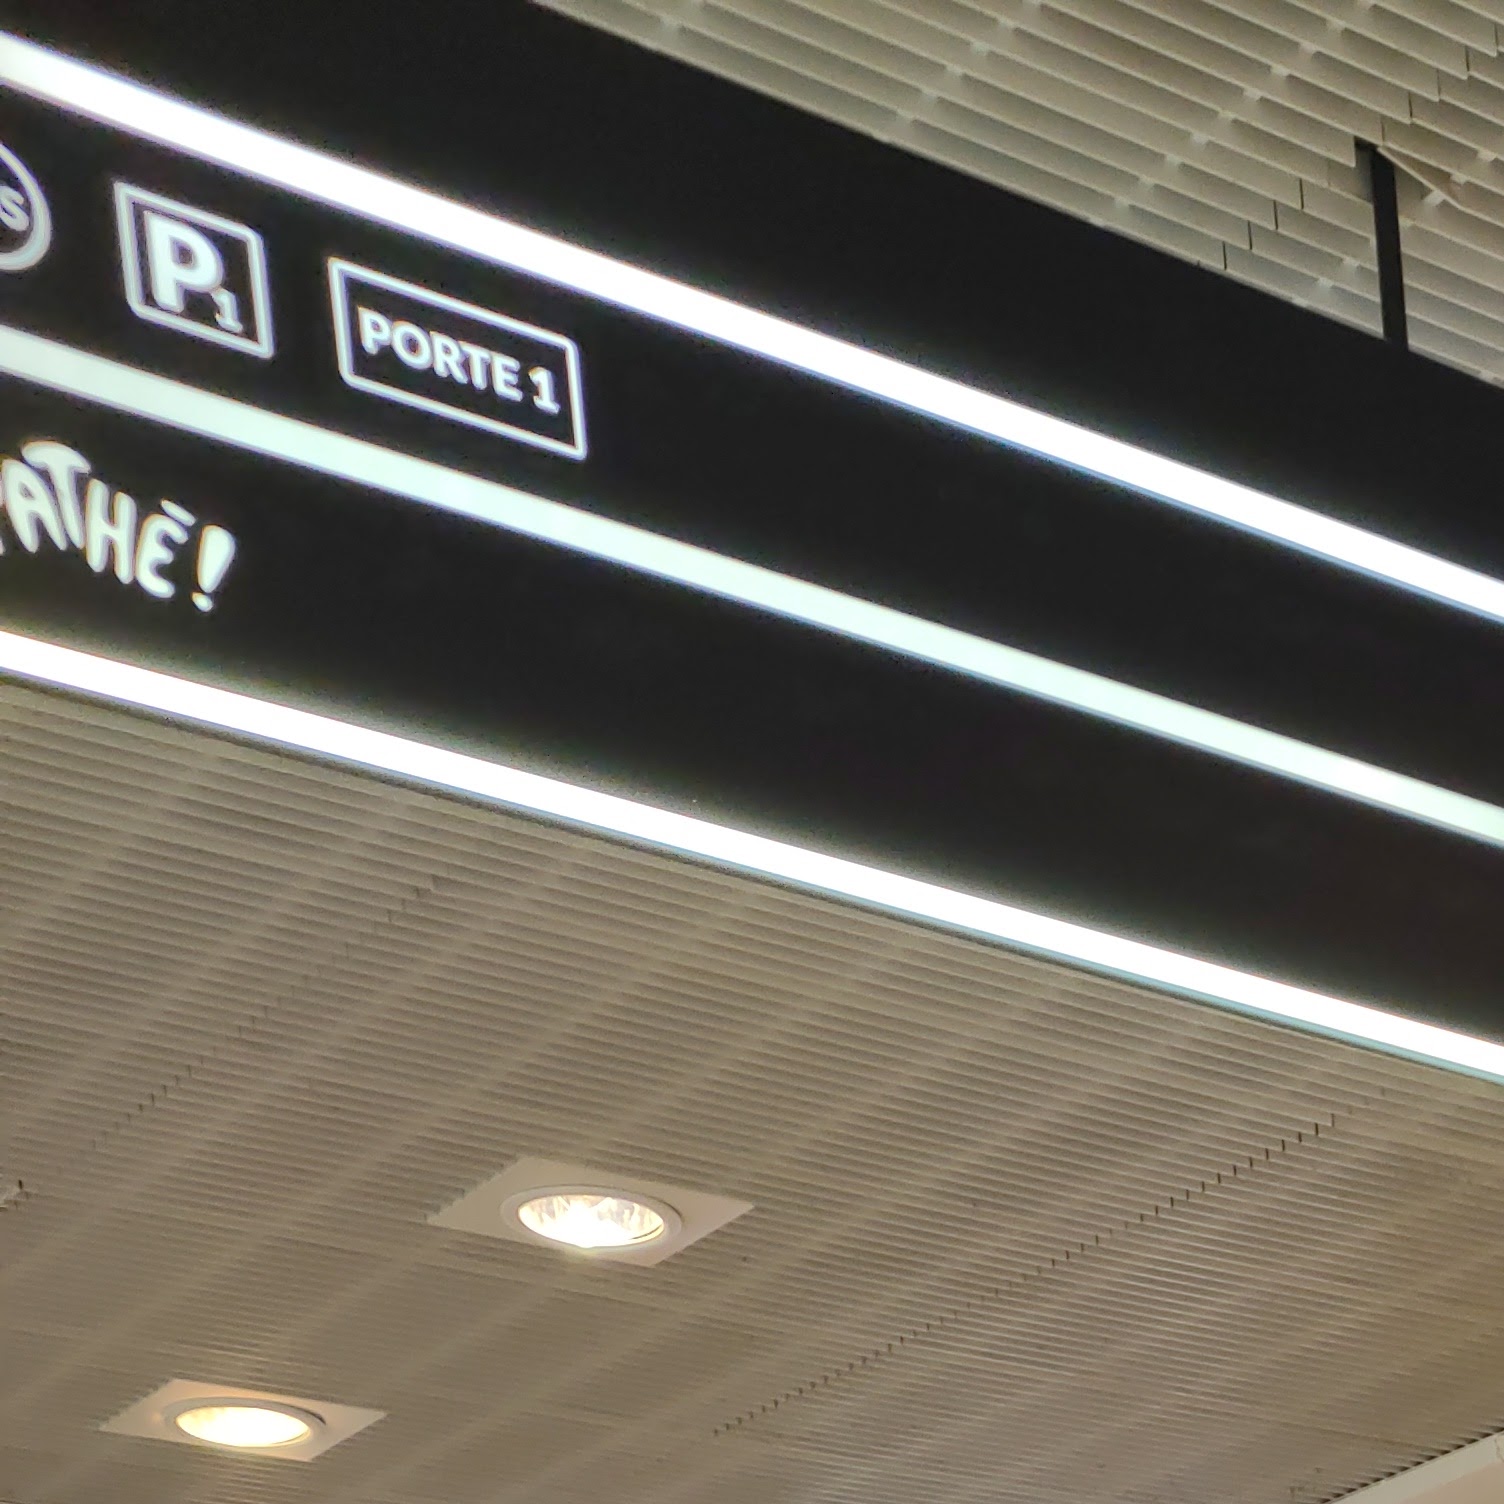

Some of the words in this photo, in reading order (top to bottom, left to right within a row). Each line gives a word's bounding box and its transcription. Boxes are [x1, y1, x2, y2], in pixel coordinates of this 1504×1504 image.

[358, 305, 524, 400] PORTE
[529, 366, 561, 414] 1
[0, 441, 236, 612] ATHÉ!
